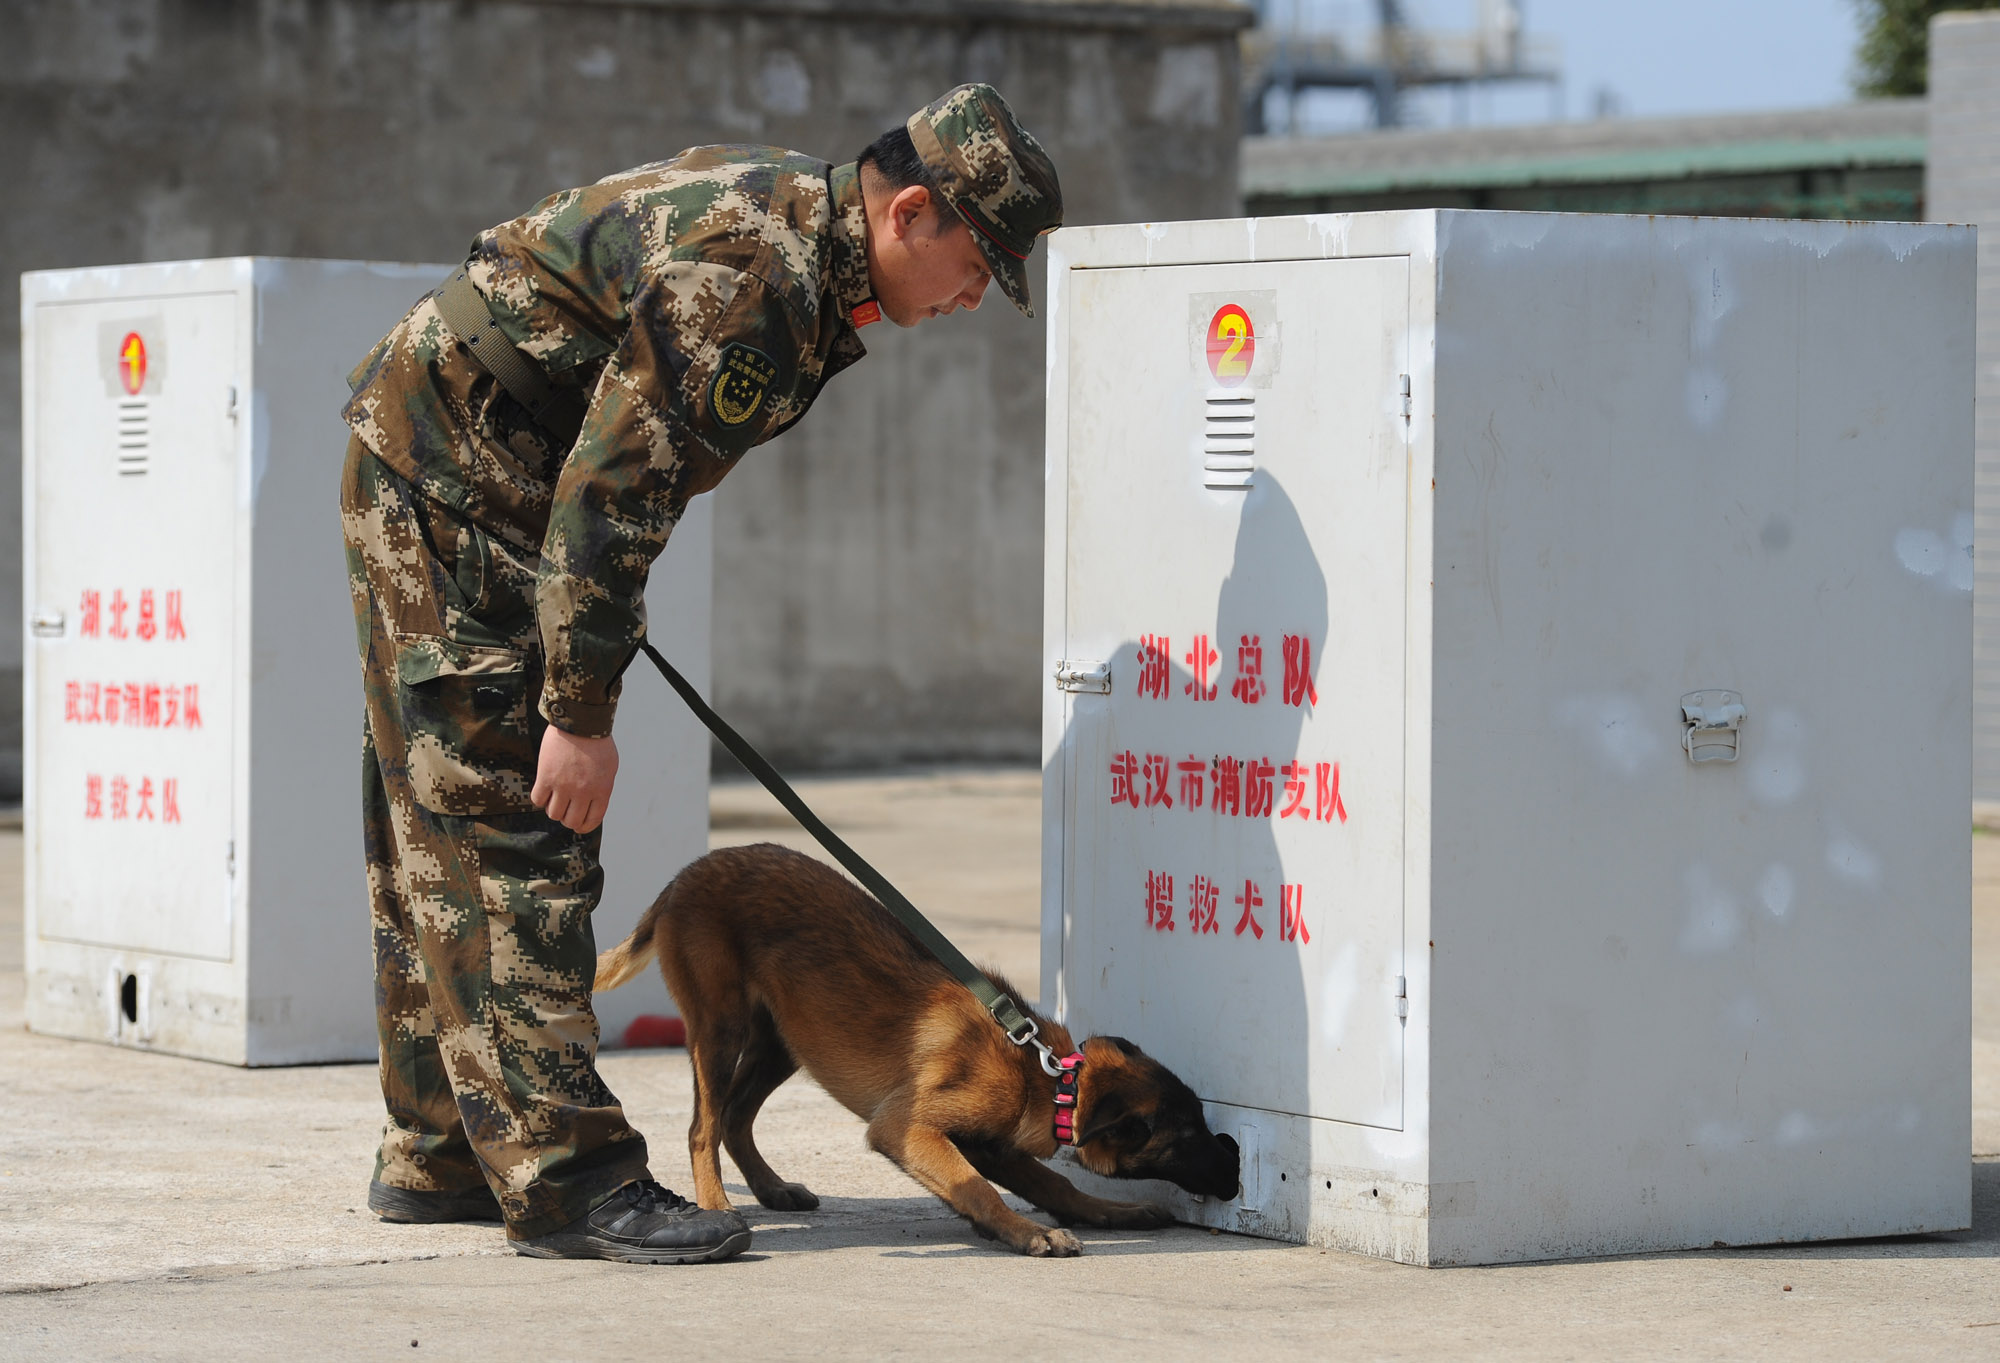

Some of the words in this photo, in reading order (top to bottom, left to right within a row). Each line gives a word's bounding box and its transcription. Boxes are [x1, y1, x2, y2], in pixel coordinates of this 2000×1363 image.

[124, 338, 140, 390] 1
[732, 348, 776, 378] 中国人民
[1216, 313, 1247, 377] 2
[80, 588, 186, 641] 湖北总队
[1136, 633, 1318, 708] 湖北总队
[64, 680, 203, 730] 武汉市消防支队
[85, 772, 182, 825] 搜救犬队
[1109, 750, 1348, 825] 武汉市消防支队
[1144, 869, 1311, 945] 搜救犬队
